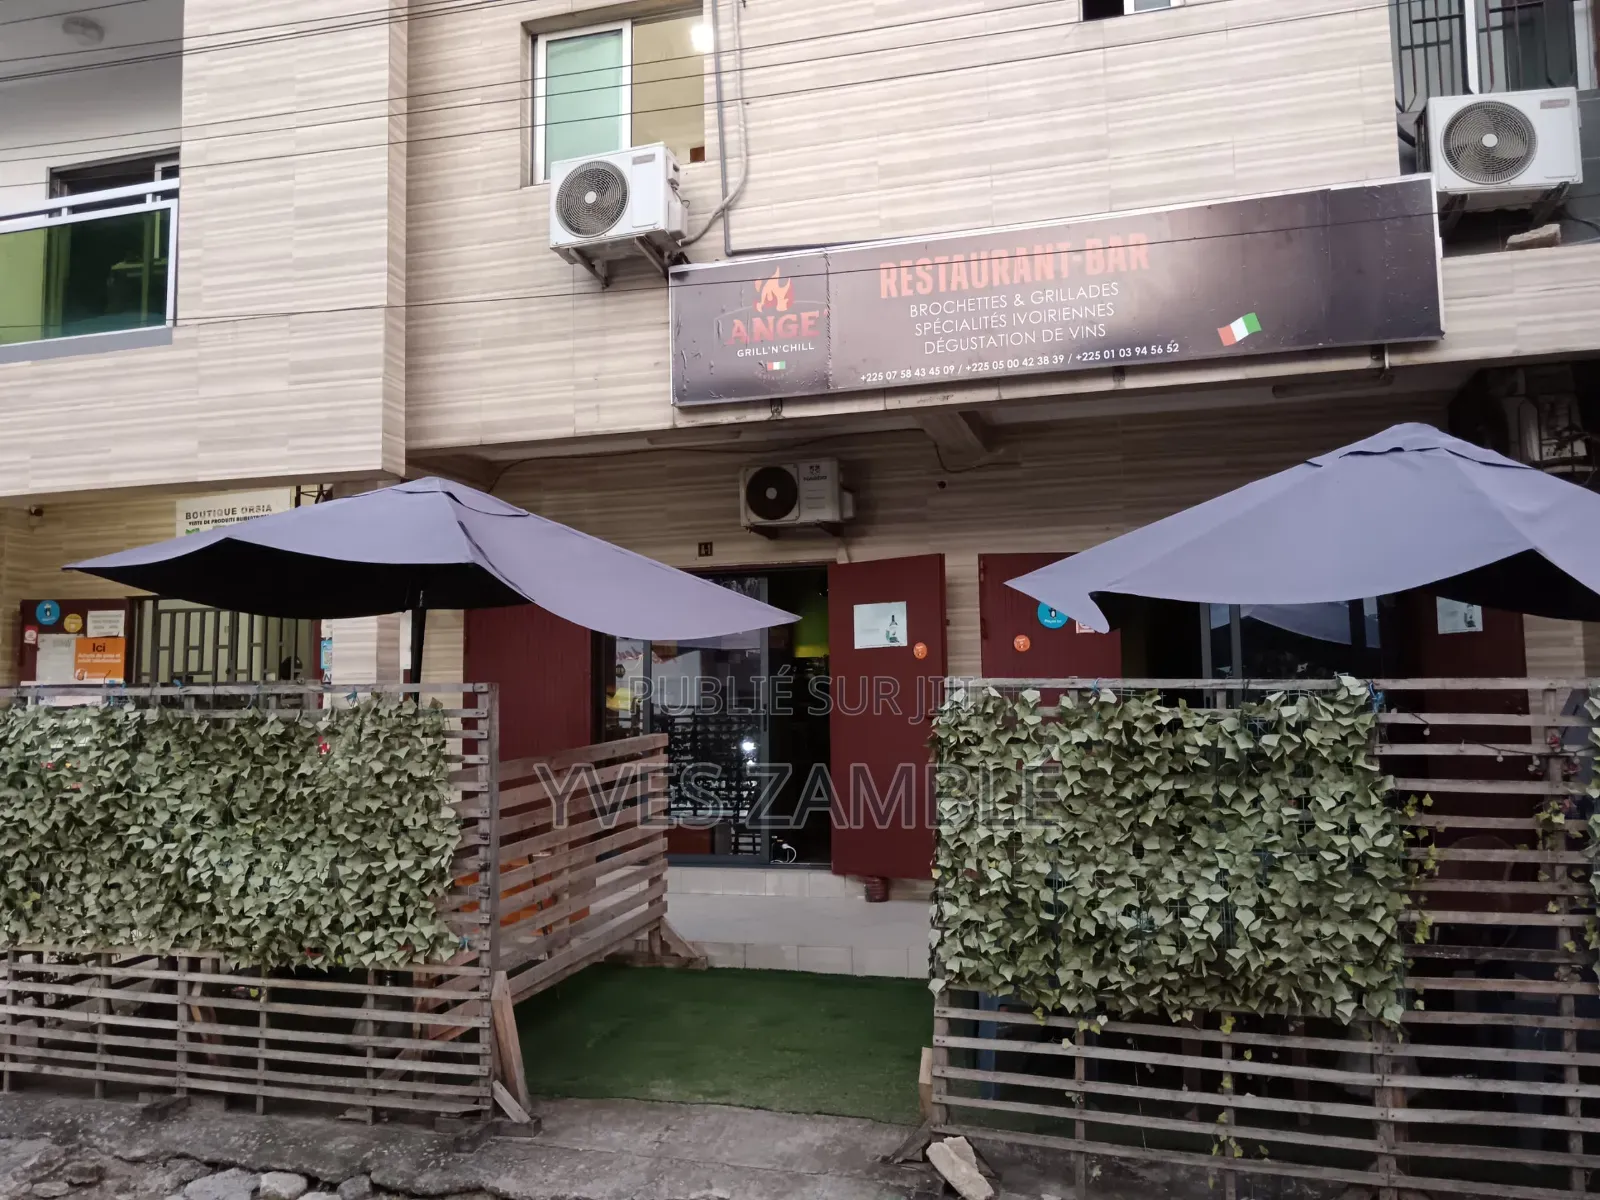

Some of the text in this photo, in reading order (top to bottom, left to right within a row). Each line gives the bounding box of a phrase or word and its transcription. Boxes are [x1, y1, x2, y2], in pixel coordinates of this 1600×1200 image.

[879, 232, 1150, 299] RESTAURANT-BAR
[909, 282, 1119, 318] BROCHETTES & GRILLADES
[914, 302, 1115, 337] SPÉCIALITÉS IVOIRIENNES
[736, 341, 815, 358] GRILL'N'CHILL
[924, 323, 1106, 355] DÉGUSTATION DE VINS
[860, 373, 884, 382] +225
[886, 371, 897, 380] 07
[900, 369, 912, 378] 58
[914, 367, 926, 377] 43
[929, 366, 941, 375] 45
[943, 365, 955, 374] 09
[965, 360, 990, 371] +225
[992, 360, 1004, 369] 05
[1007, 358, 1020, 368] 00
[1022, 357, 1034, 367] 42
[1037, 355, 1050, 365] 38
[1052, 354, 1065, 364] 39
[1075, 350, 1101, 361] +225
[1103, 349, 1116, 359] 01
[1119, 347, 1132, 358] 03
[1134, 345, 1148, 356] 94
[1150, 344, 1163, 355] 56
[1166, 343, 1180, 353] 52
[185, 507, 237, 520] BOUTIQUE
[92, 642, 106, 653] Ici
